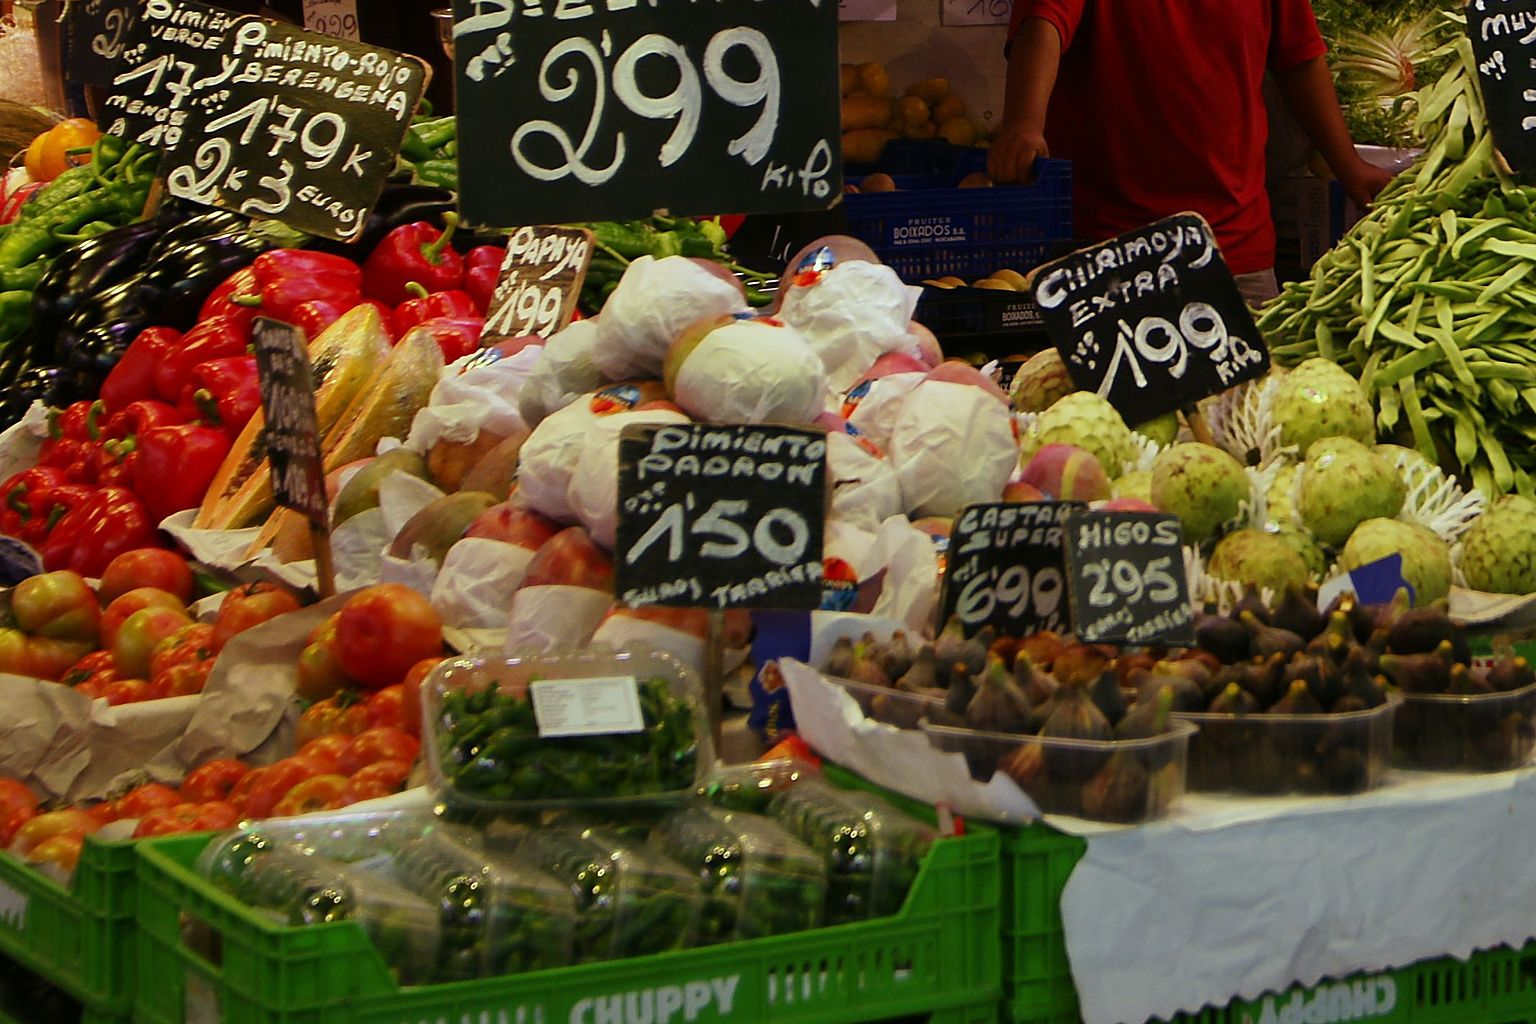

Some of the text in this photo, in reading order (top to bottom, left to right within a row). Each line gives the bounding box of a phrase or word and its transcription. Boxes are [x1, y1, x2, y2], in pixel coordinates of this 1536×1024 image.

[893, 225, 951, 239] BOIXADOS
[501, 226, 588, 280] PAPAYA
[1077, 517, 1179, 549] HIGOS
[569, 974, 741, 1024] CHUPPY
